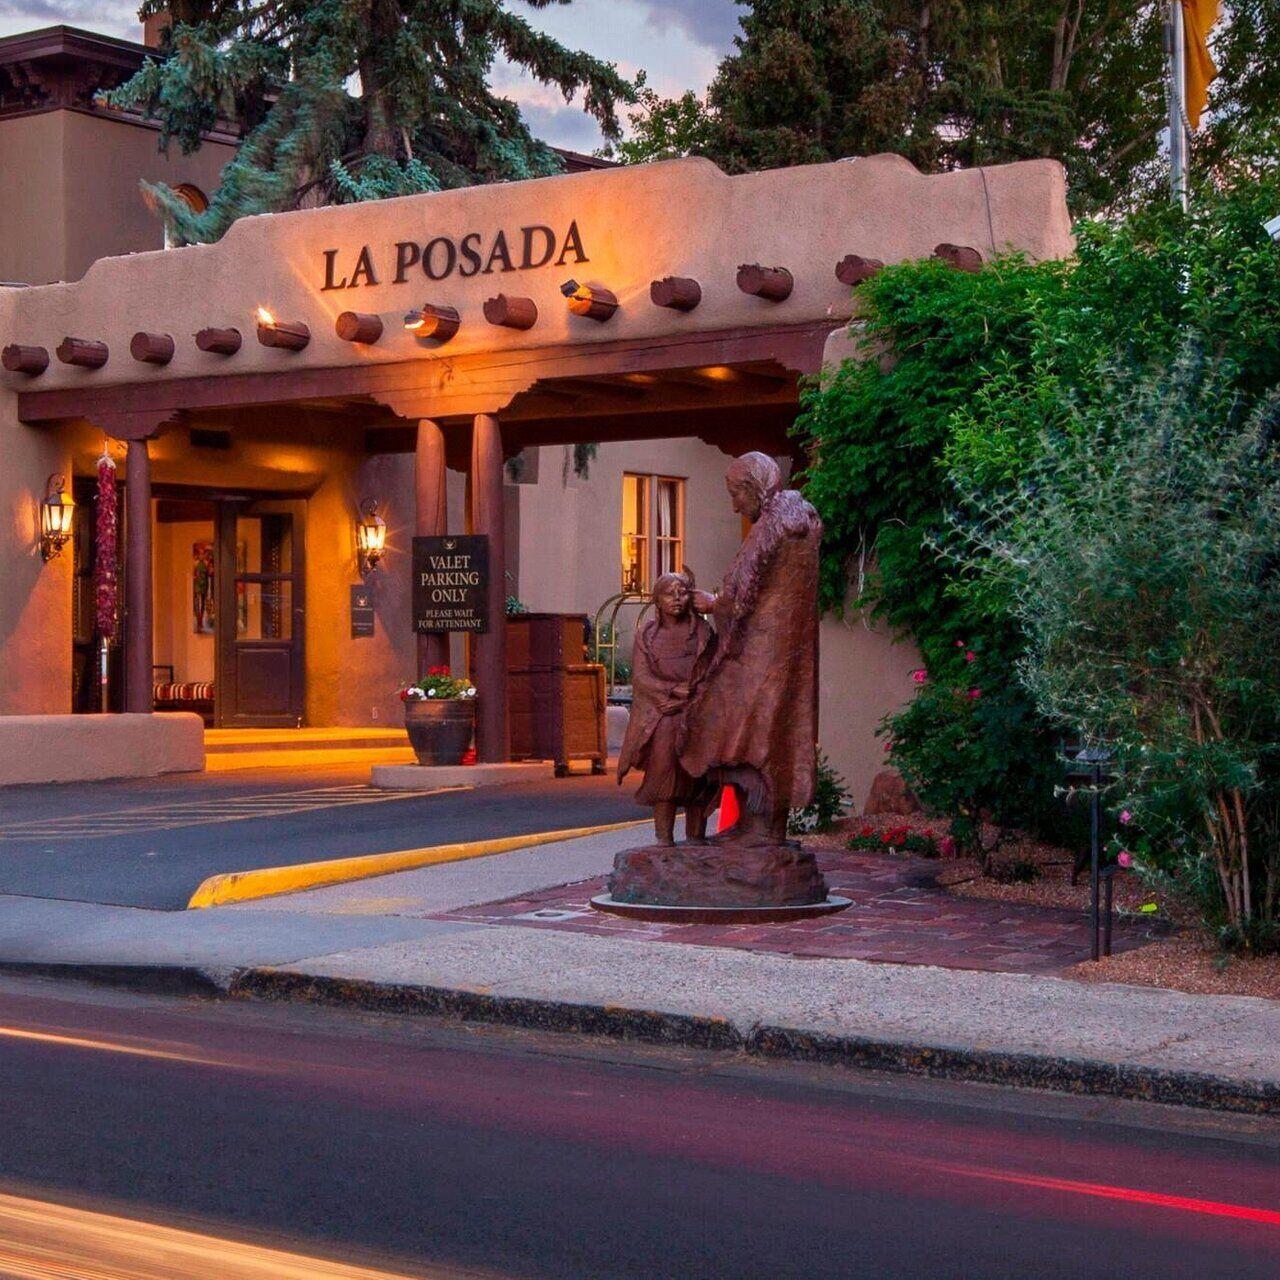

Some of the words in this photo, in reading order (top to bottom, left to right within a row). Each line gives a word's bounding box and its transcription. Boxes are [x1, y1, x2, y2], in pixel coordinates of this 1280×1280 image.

[320, 246, 381, 291] LA
[392, 219, 590, 284] POSADA
[429, 555, 471, 569] VALET
[421, 571, 480, 586] PARKING
[431, 588, 468, 603] ONLY
[426, 609, 453, 618] PLEASE
[454, 609, 474, 618] WAIT
[418, 620, 433, 629] FOR
[435, 619, 481, 628] ATTENDANT
